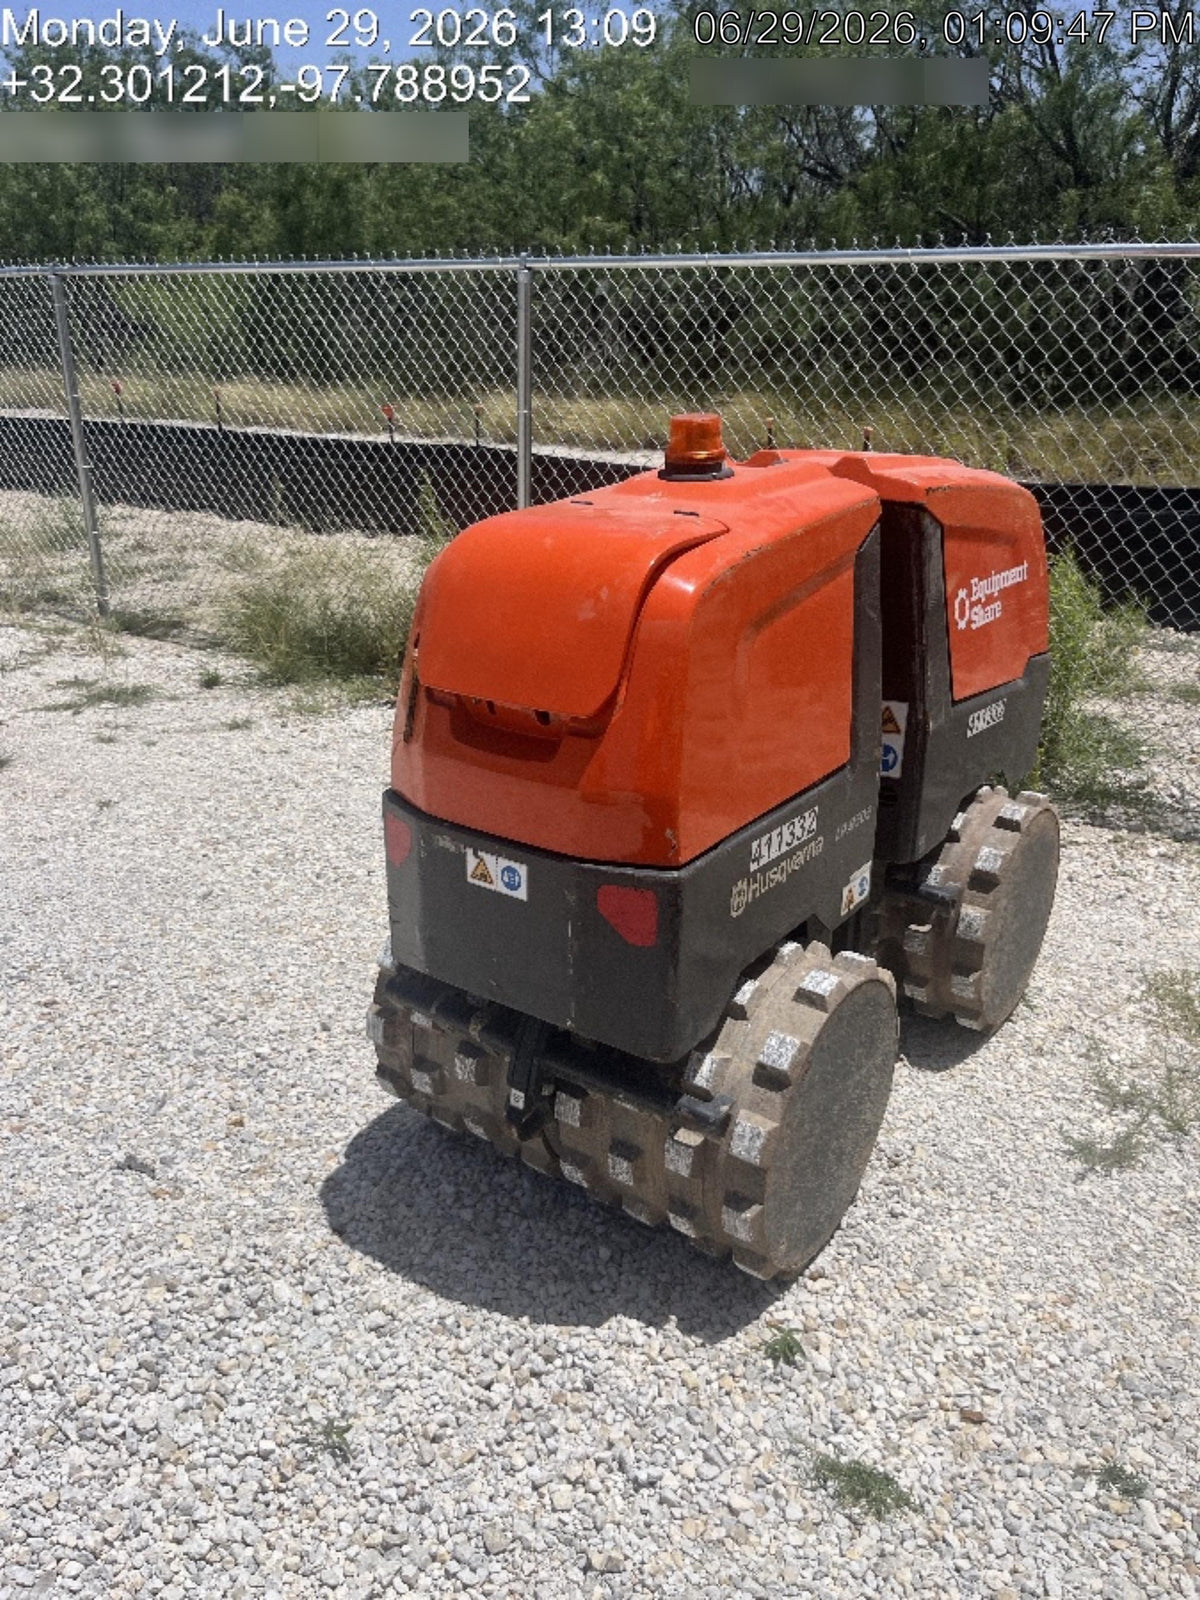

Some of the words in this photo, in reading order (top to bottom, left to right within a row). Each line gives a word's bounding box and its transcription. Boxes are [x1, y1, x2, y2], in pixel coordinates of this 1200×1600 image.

[970, 559, 1029, 602] Equipment
[970, 599, 1002, 630] Share
[751, 806, 819, 868] 411332
[748, 836, 824, 902] Husqvarna
